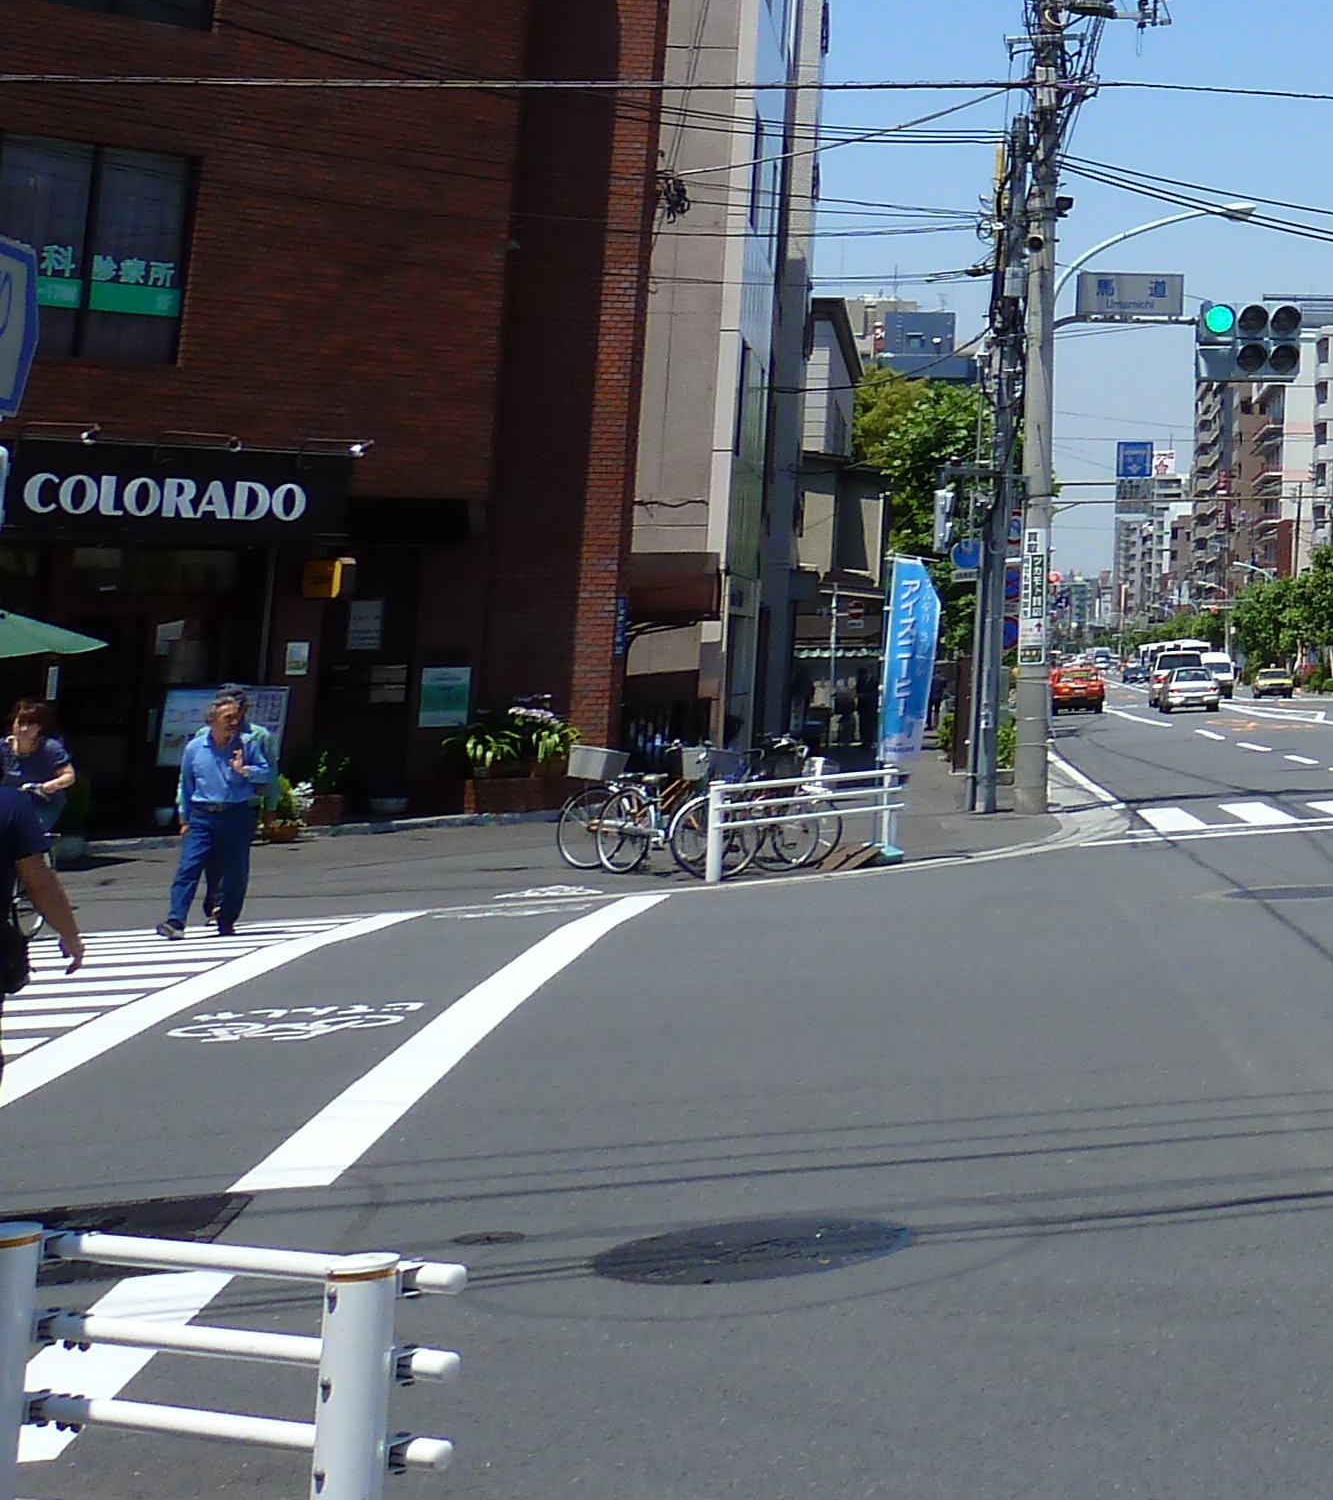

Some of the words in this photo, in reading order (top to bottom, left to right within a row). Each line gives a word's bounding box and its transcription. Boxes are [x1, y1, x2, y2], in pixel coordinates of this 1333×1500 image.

[1096, 278, 1168, 298] 馬道
[1106, 299, 1155, 311] Umamichi
[23, 472, 308, 522] COLORADO
[894, 578, 921, 718] アイスコーヒー
